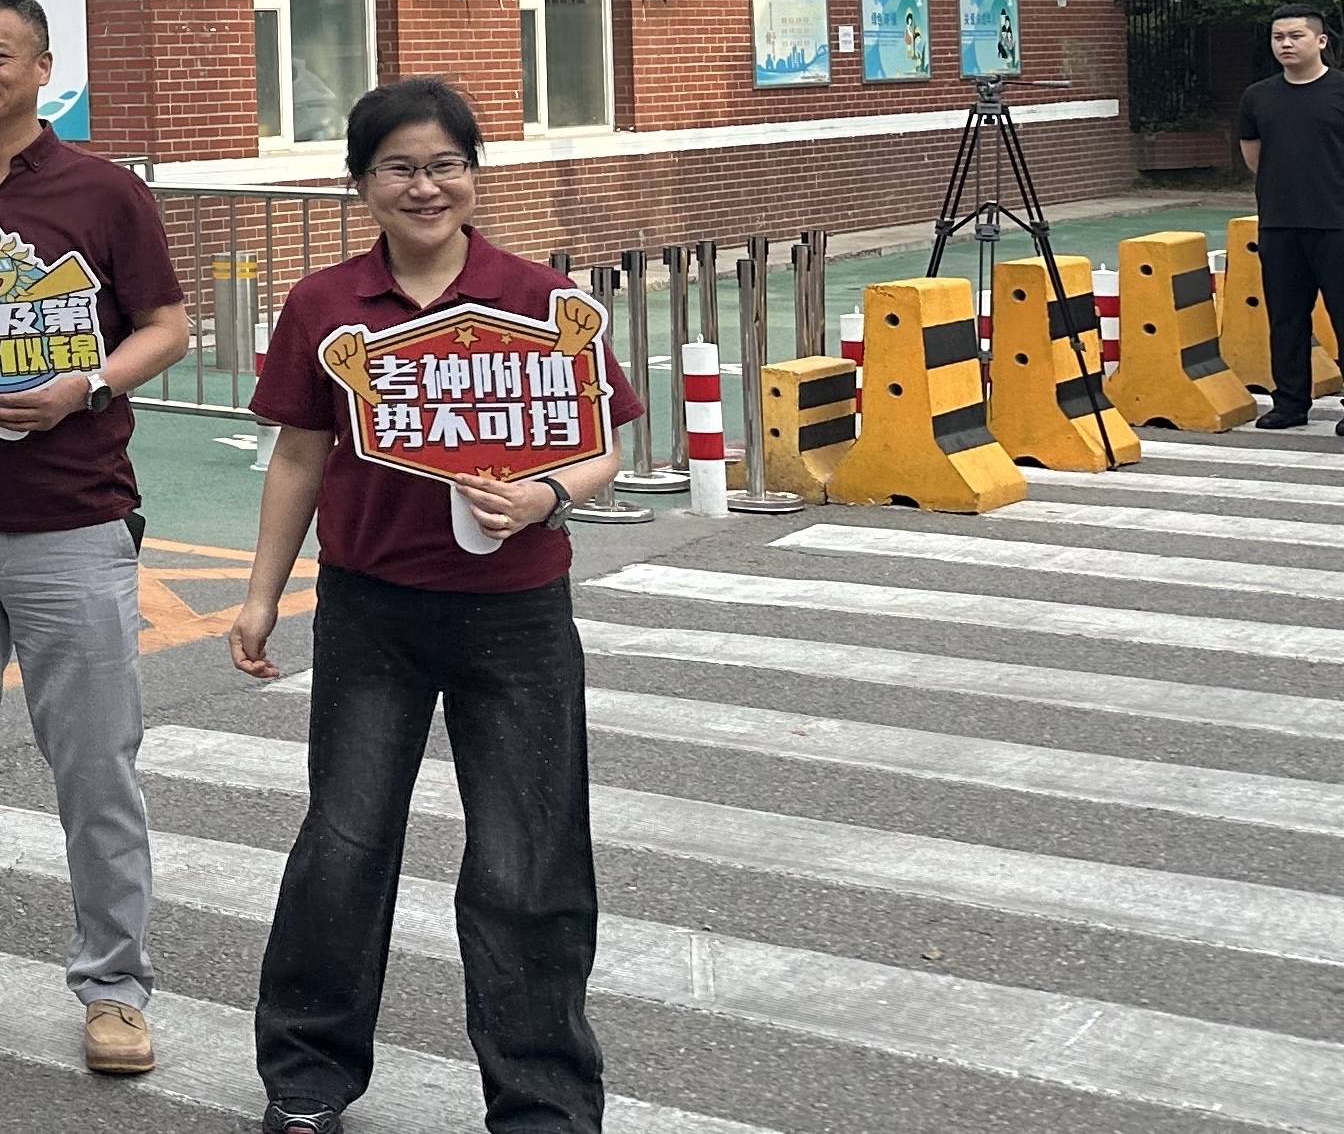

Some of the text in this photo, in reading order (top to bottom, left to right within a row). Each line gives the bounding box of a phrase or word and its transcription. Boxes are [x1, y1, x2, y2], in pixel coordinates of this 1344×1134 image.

[368, 351, 577, 401] 考神附体
[374, 400, 581, 450] 势不可挡
